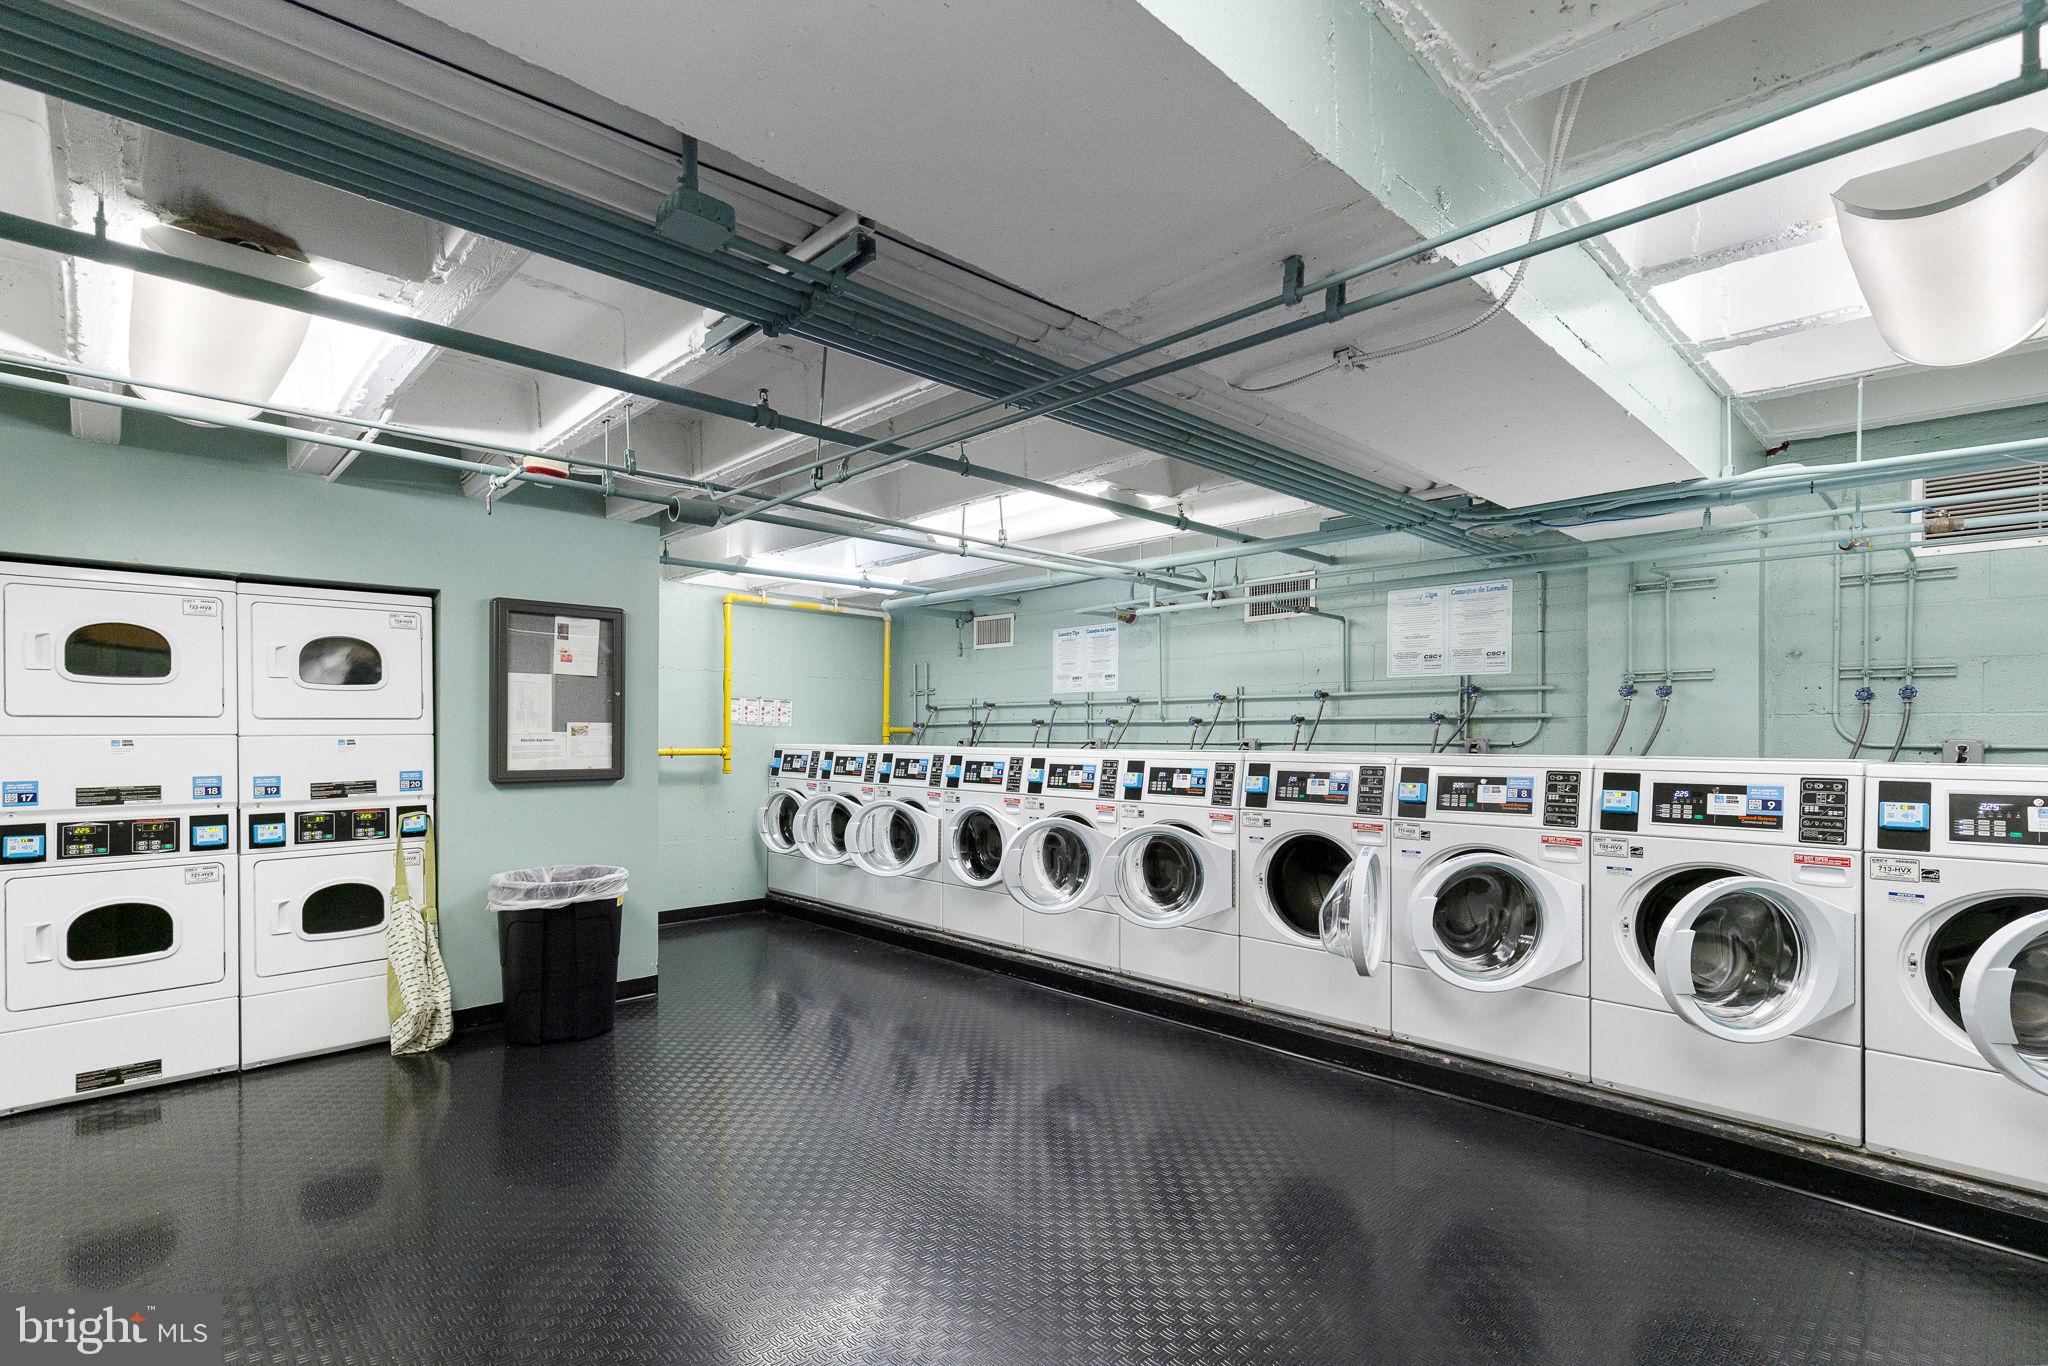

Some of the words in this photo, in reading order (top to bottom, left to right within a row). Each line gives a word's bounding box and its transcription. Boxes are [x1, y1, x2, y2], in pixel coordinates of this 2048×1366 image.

[1450, 588, 1477, 596] Consejos
[20, 794, 34, 802] 17
[1767, 801, 1775, 810] 9
